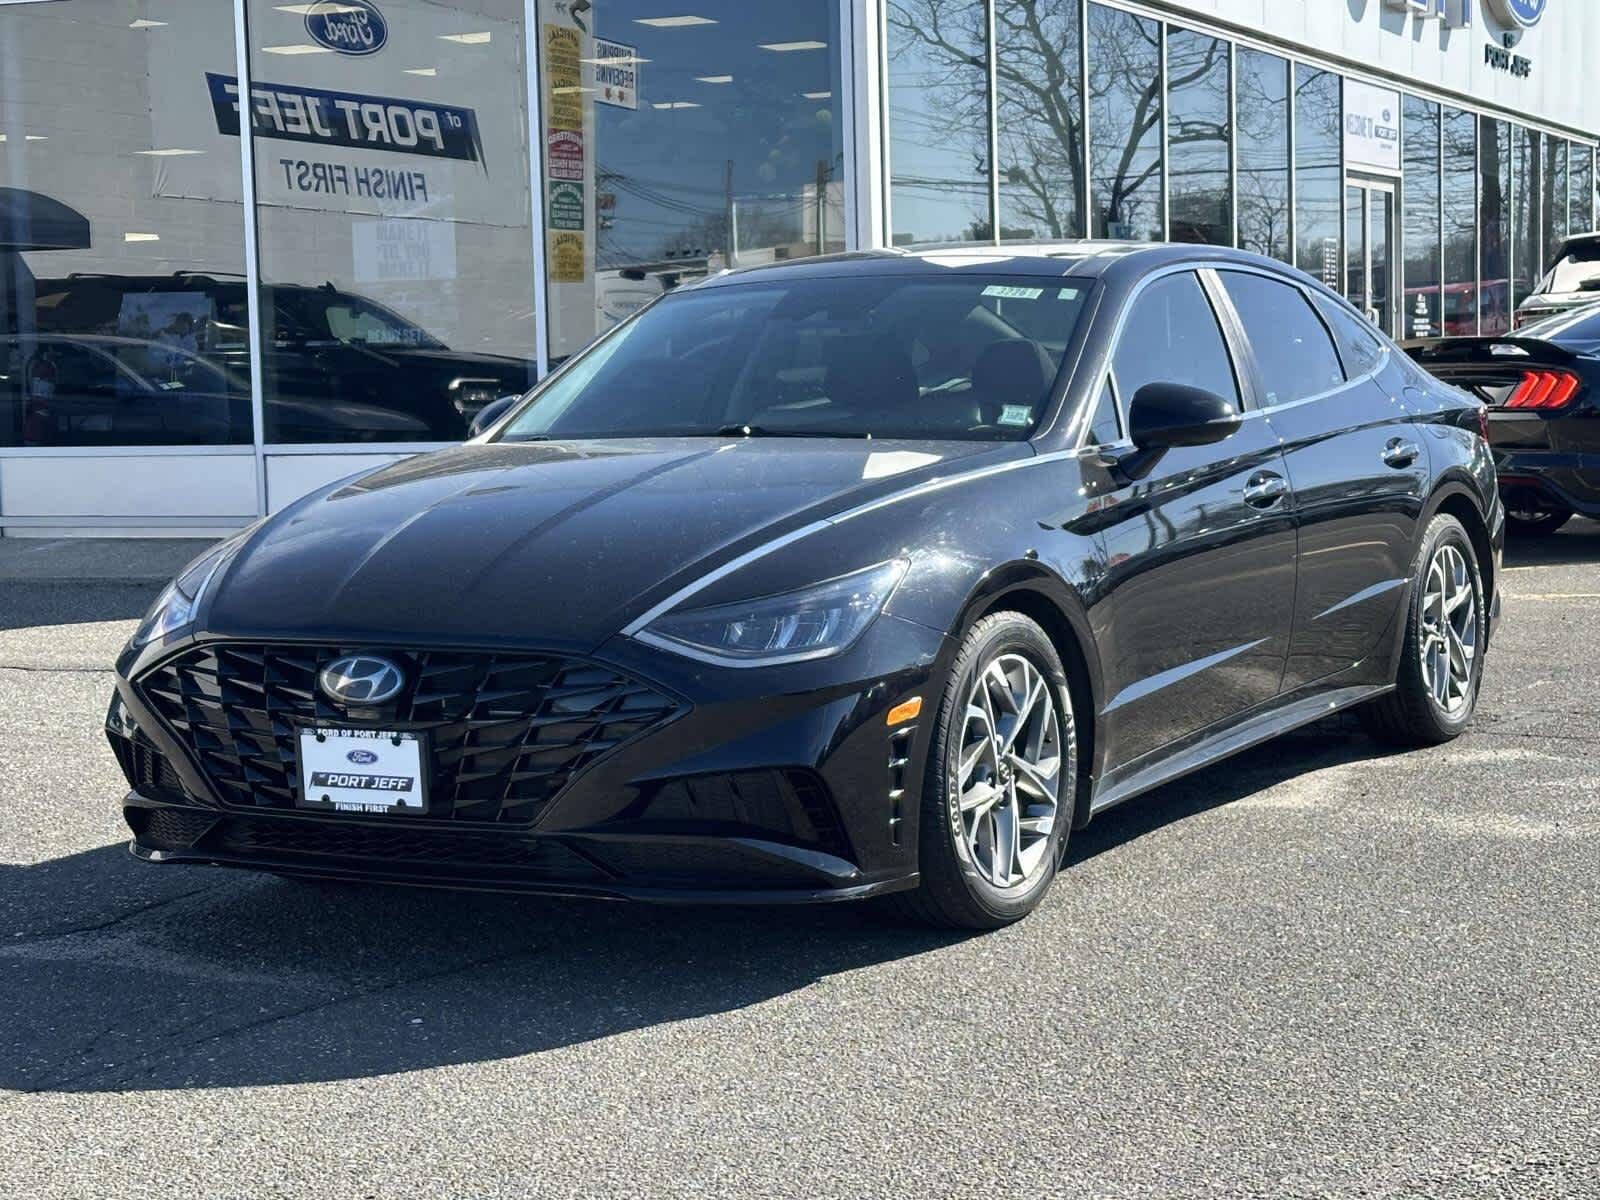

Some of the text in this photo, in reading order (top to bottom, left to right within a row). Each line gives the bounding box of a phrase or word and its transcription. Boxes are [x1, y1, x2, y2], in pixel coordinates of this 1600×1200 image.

[1484, 43, 1532, 79] PORT JEFF
[317, 728, 339, 738] FORD
[341, 729, 352, 738] OF
[354, 729, 377, 739] PORT
[378, 731, 398, 740] JEFF
[327, 774, 369, 787] PORT
[370, 777, 409, 790] JEFF
[335, 802, 389, 813] FINISH FIRST
